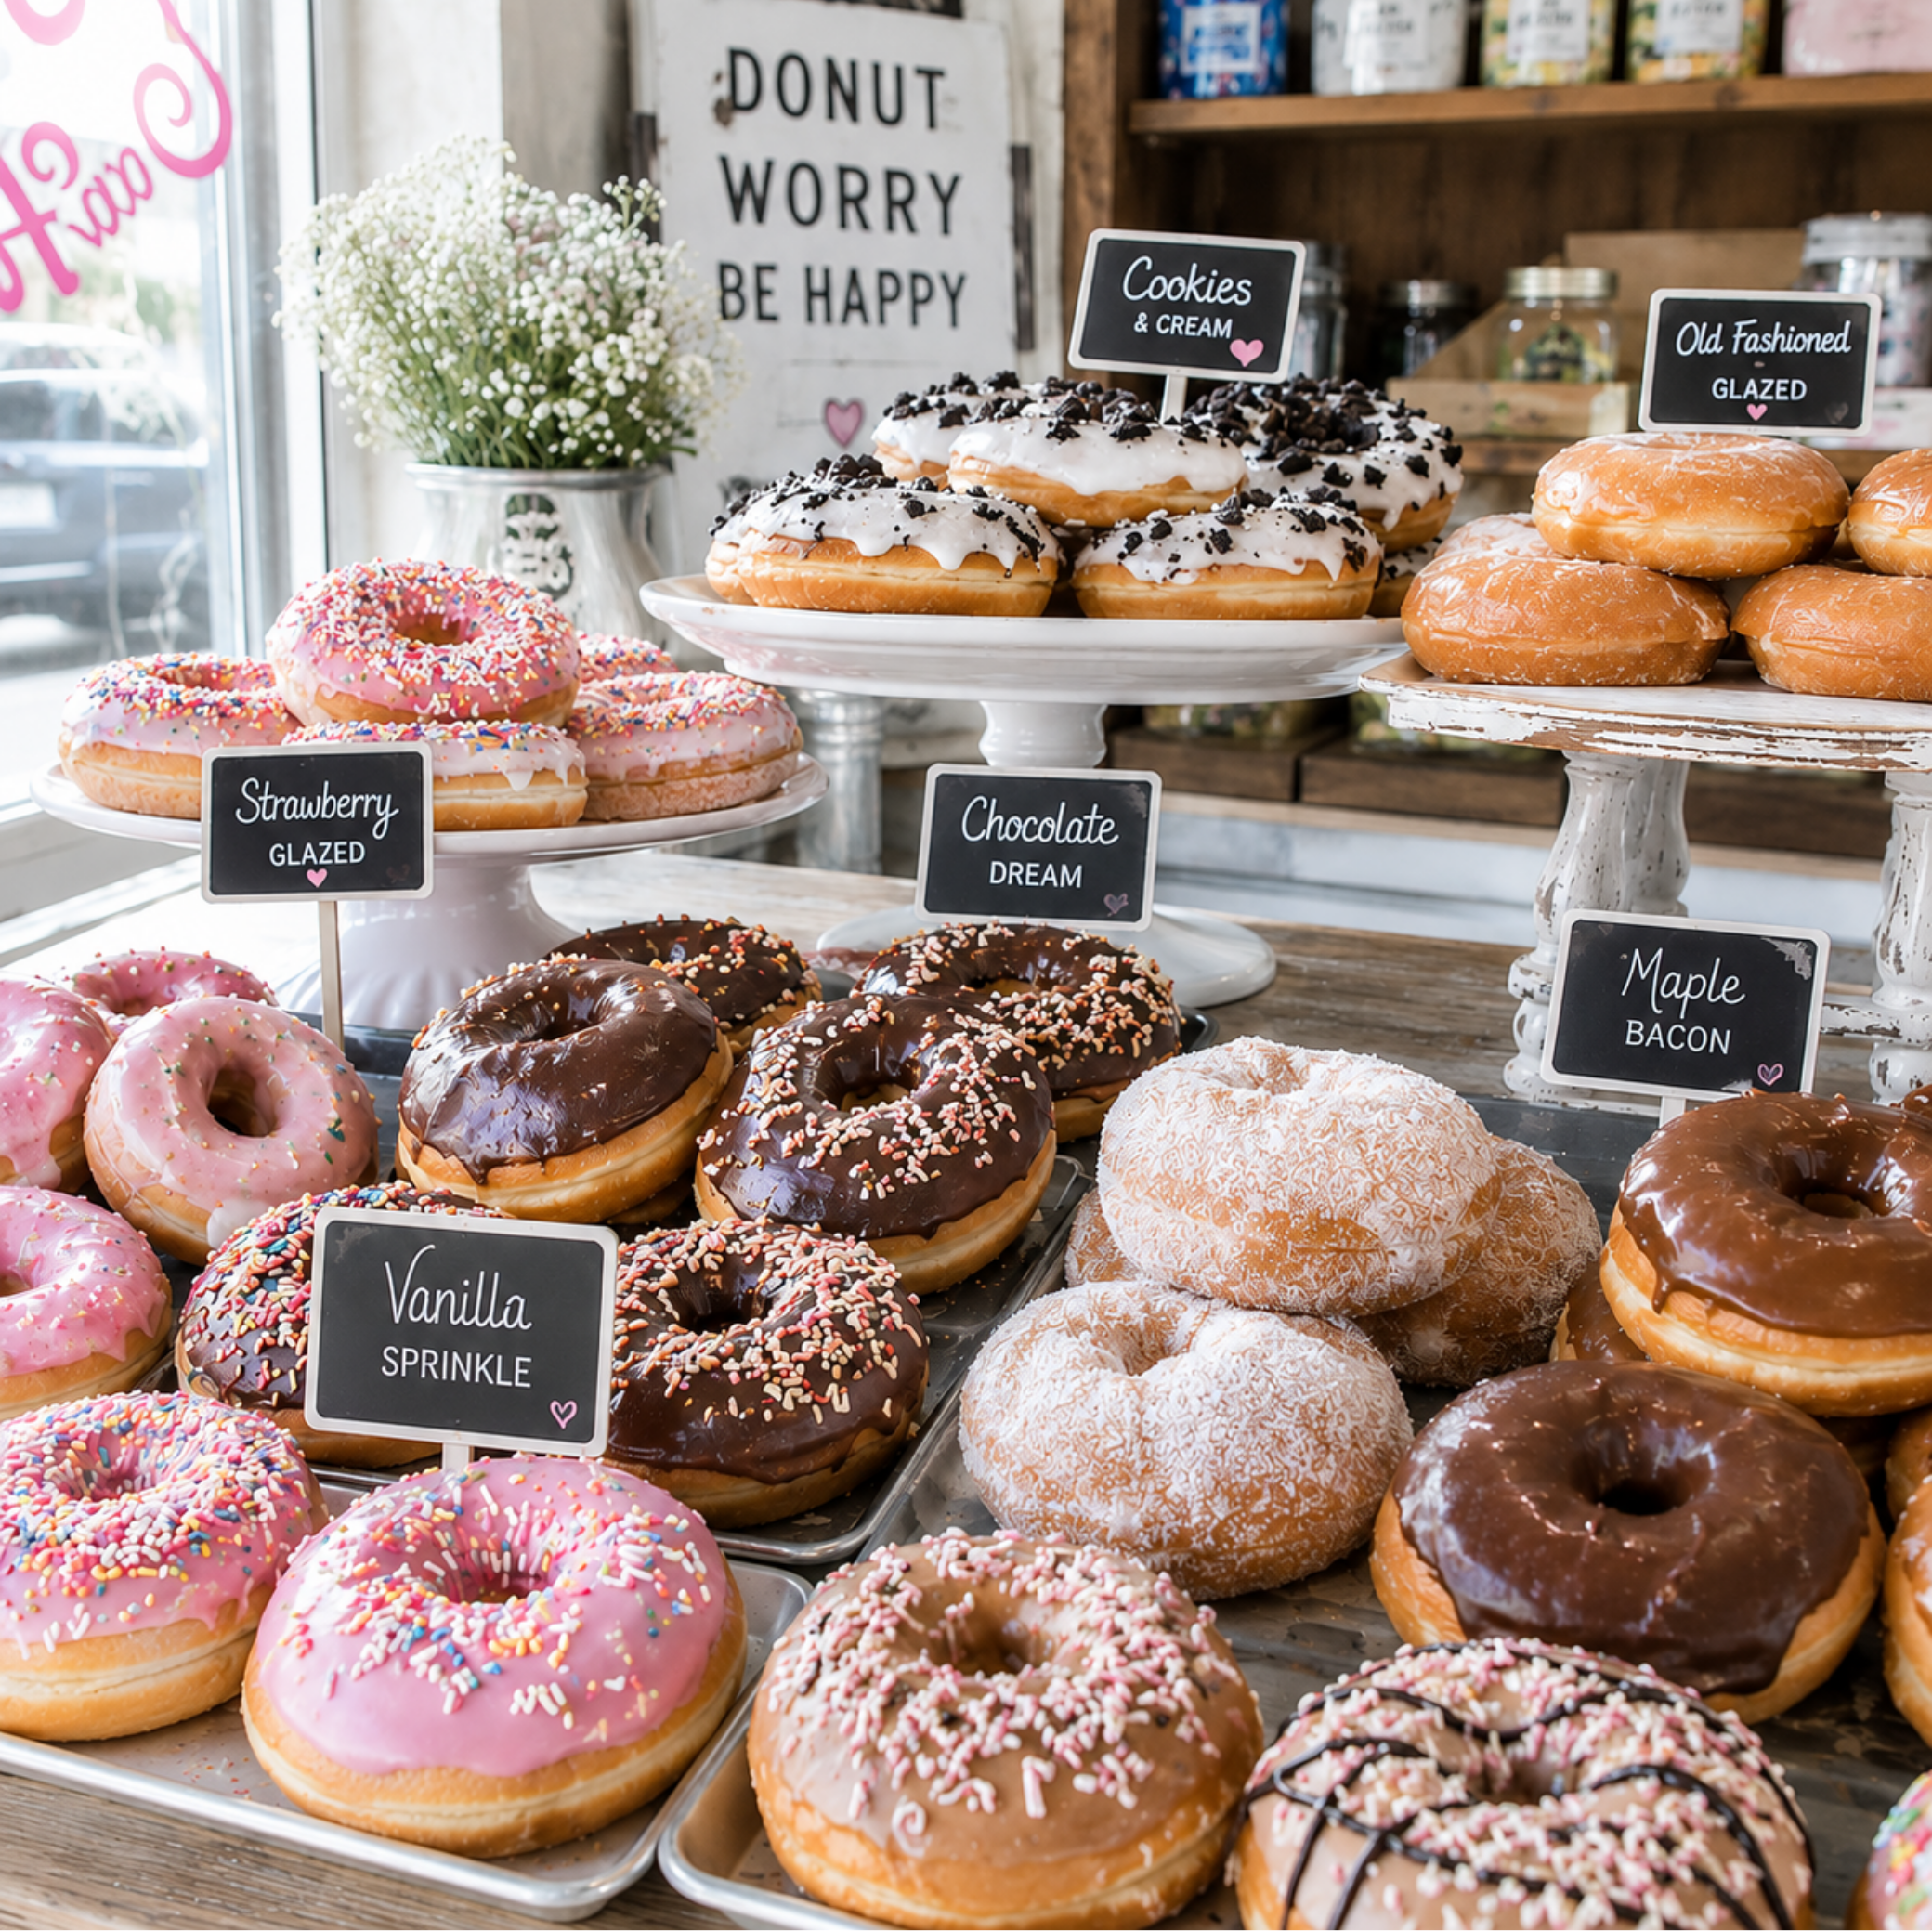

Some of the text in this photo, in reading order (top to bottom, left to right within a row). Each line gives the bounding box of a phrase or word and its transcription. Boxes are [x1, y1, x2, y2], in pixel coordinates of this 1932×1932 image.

[728, 47, 946, 130] DONUT
[719, 155, 961, 236] WORRY
[718, 262, 967, 328] BE HAPPY
[1122, 255, 1253, 307] Cookies
[1133, 311, 1234, 340] & CREAM
[1675, 318, 1852, 357] Old Fashioned
[1711, 377, 1808, 402] GLAZED
[235, 777, 400, 841] Strawberry
[961, 795, 1120, 845] Chocolate
[268, 841, 366, 867] GLAZED
[989, 860, 1083, 889] DREAM
[1621, 946, 1746, 1020] Maple
[1625, 1019, 1731, 1055] BACON
[384, 1244, 533, 1330] Vanilla
[381, 1345, 533, 1388] SPRINKLE
